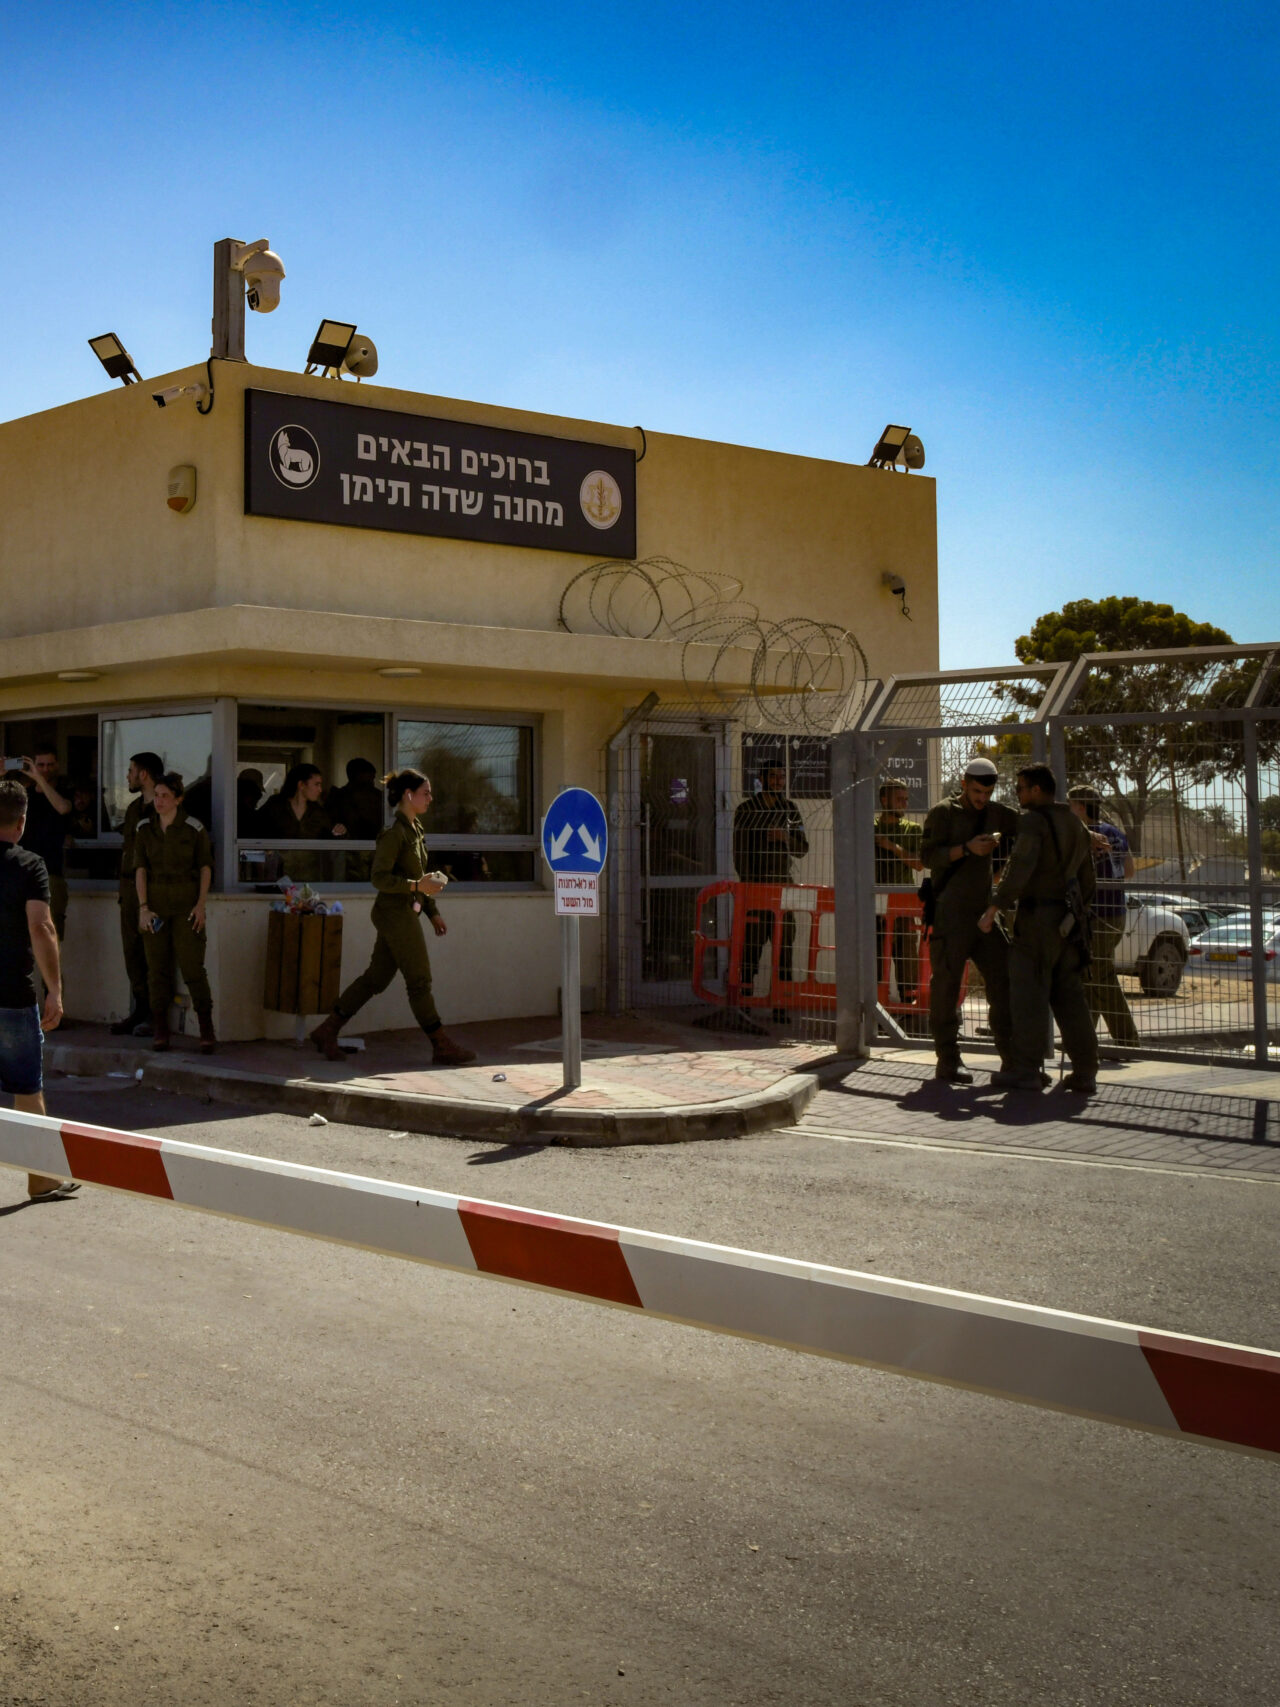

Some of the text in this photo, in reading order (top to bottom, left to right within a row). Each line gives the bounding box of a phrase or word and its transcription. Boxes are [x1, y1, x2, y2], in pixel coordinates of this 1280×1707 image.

[357, 433, 551, 486] ברוכים הבאים
[340, 473, 411, 508] תימן
[421, 483, 484, 516] שדה
[493, 494, 564, 527] מחנה
[887, 757, 914, 768] כניסת
[582, 897, 593, 907] מול
